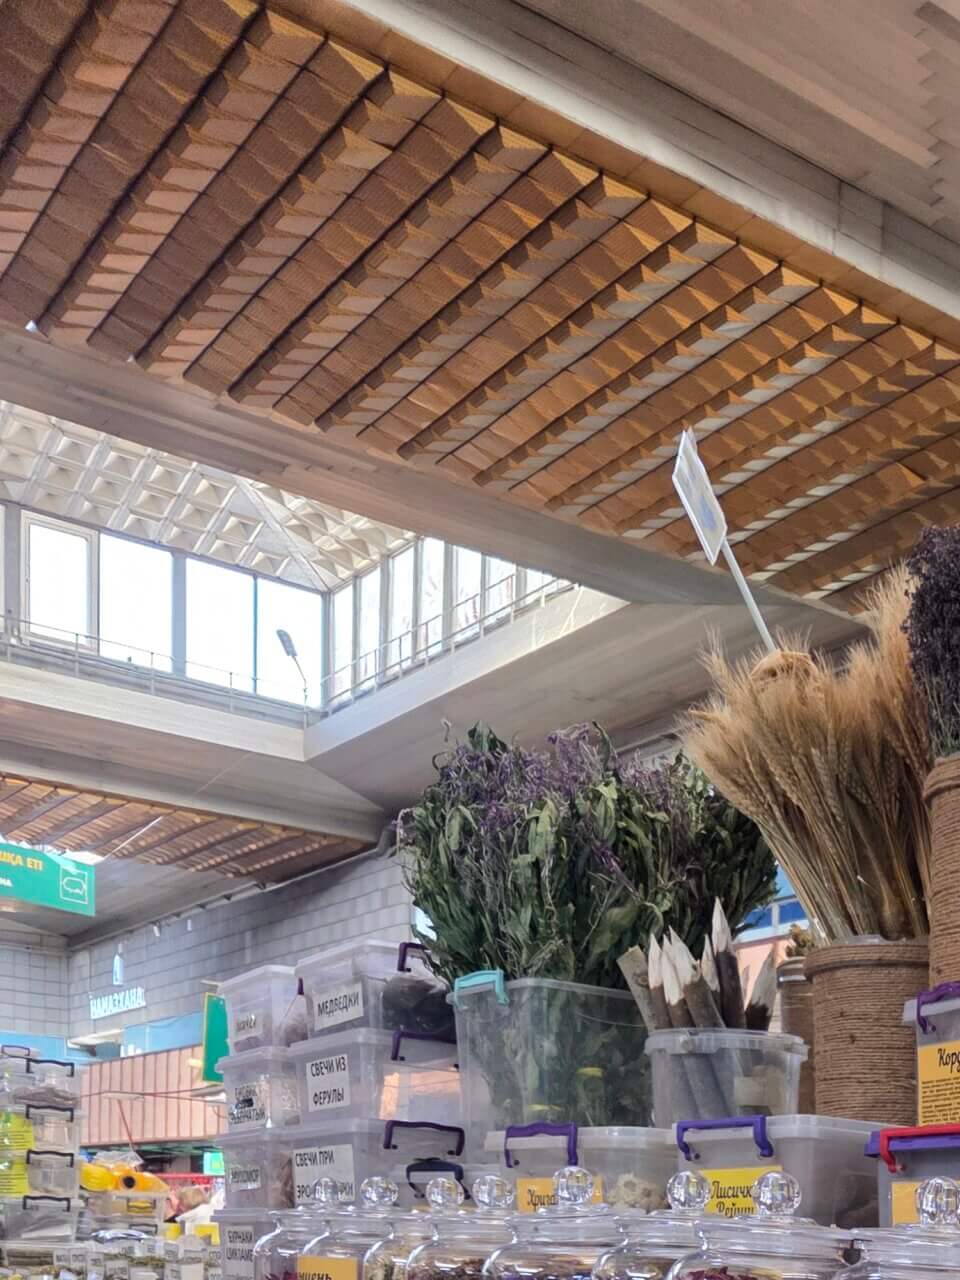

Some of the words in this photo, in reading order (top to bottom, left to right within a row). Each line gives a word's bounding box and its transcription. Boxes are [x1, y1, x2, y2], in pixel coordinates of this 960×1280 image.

[317, 991, 359, 1017] МЕДВЕДКИ
[310, 1058, 335, 1077] СВЕЧИ
[336, 1056, 346, 1071] ИЗ
[312, 1087, 345, 1106] ФЕРУЛЫ
[295, 1151, 318, 1167] СВЕЧИ
